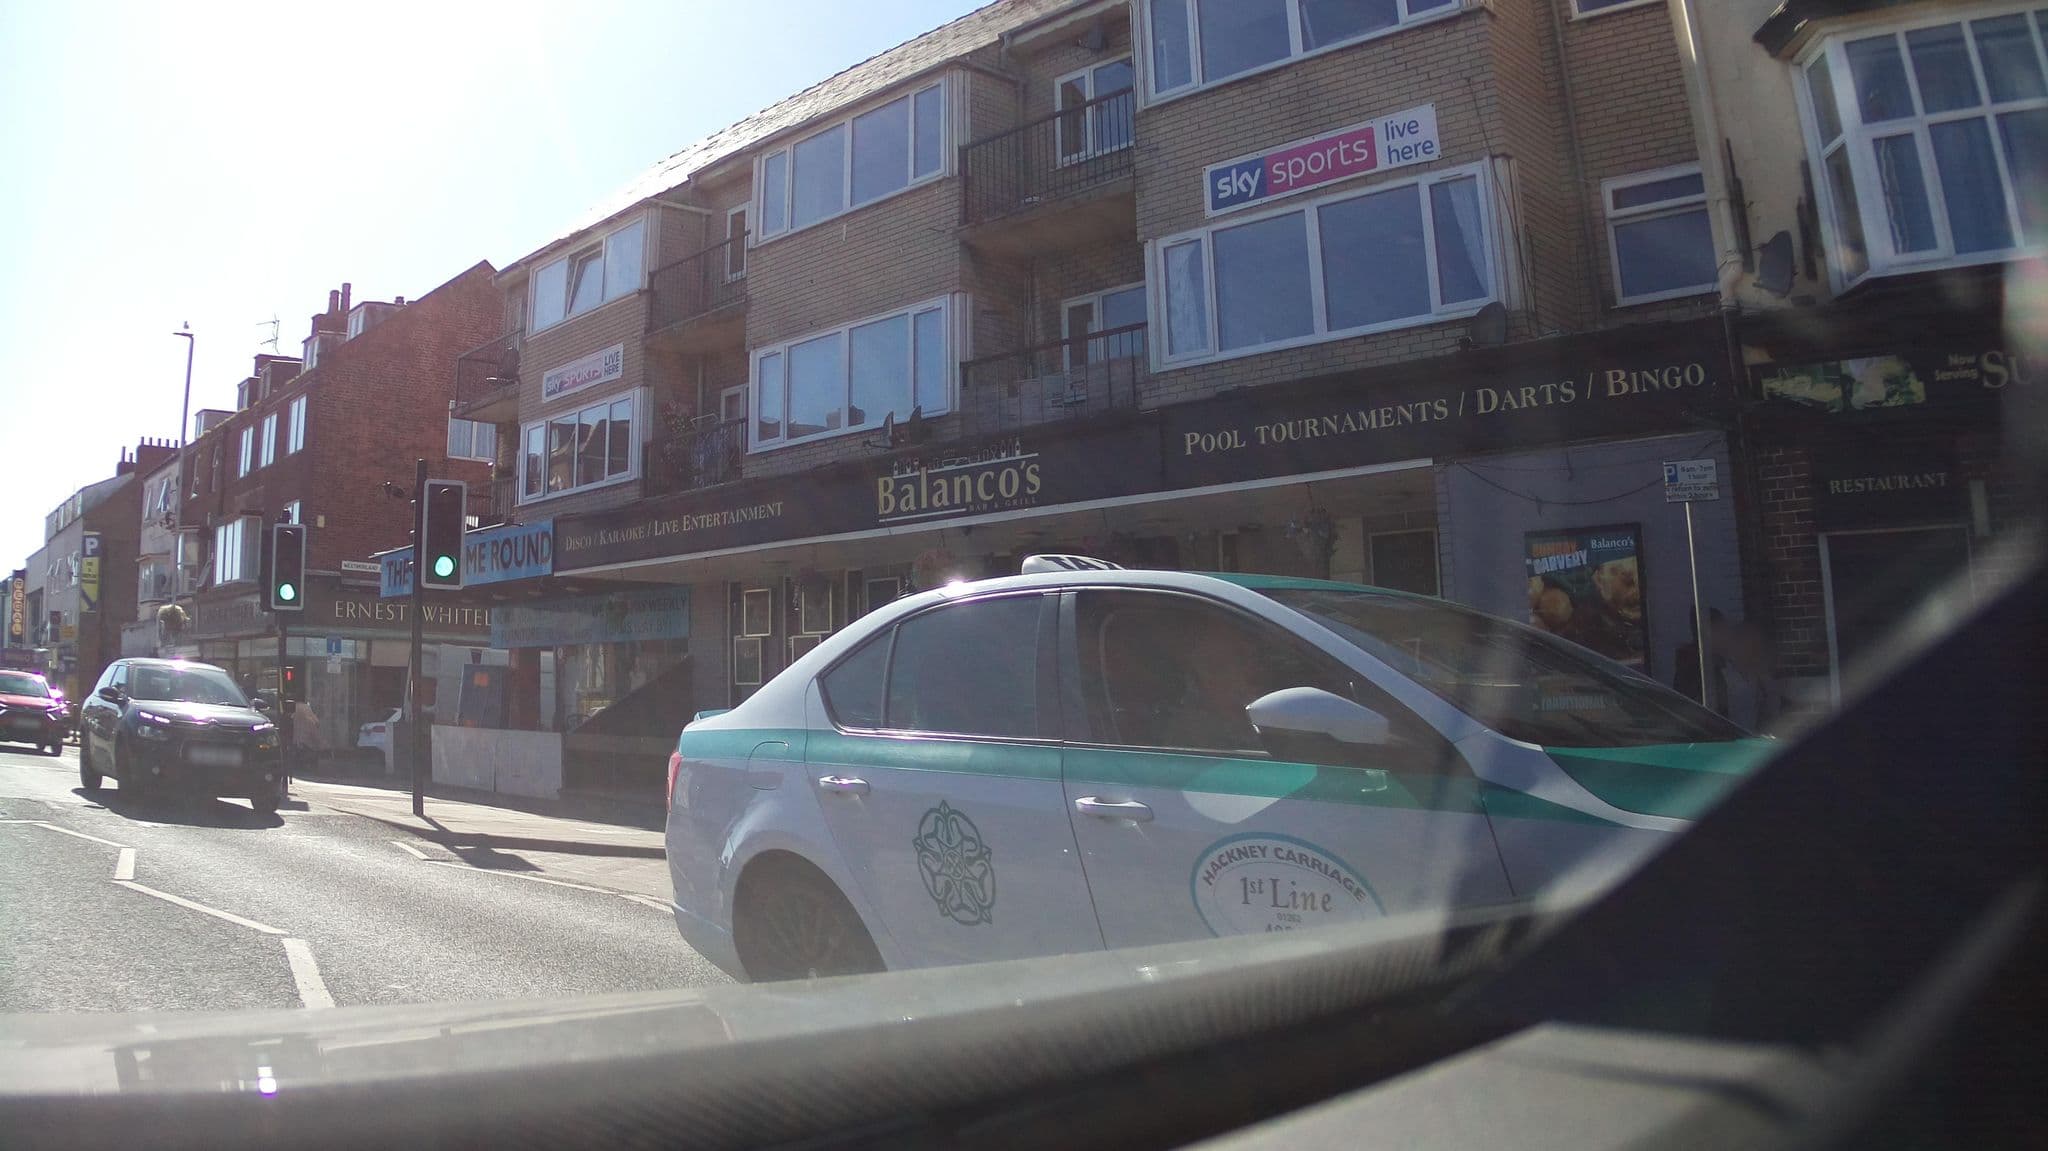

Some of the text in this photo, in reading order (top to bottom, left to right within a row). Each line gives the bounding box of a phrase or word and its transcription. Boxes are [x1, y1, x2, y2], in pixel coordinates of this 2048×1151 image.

[1384, 119, 1419, 141] live
[1217, 139, 1368, 198] sky sports
[1387, 139, 1434, 164] here
[1184, 430, 1246, 456] POOL
[1255, 399, 1449, 445] TOURNAMENTS
[1475, 381, 1576, 414] DARTS
[1605, 363, 1705, 397] BINGO
[878, 461, 1041, 515] Balanco's
[1829, 472, 1948, 494] RESTAURANT
[565, 535, 592, 551] DISCO
[600, 526, 645, 545] KARAOKE
[654, 519, 679, 536] LIVE
[683, 502, 784, 531] ENTERTAINMENT
[85, 537, 98, 555] P
[491, 531, 552, 570] ROUND
[335, 600, 408, 621] ERNEST
[1203, 845, 1367, 903] HACKNEY CARRIAGE
[1269, 877, 1333, 912] Line
